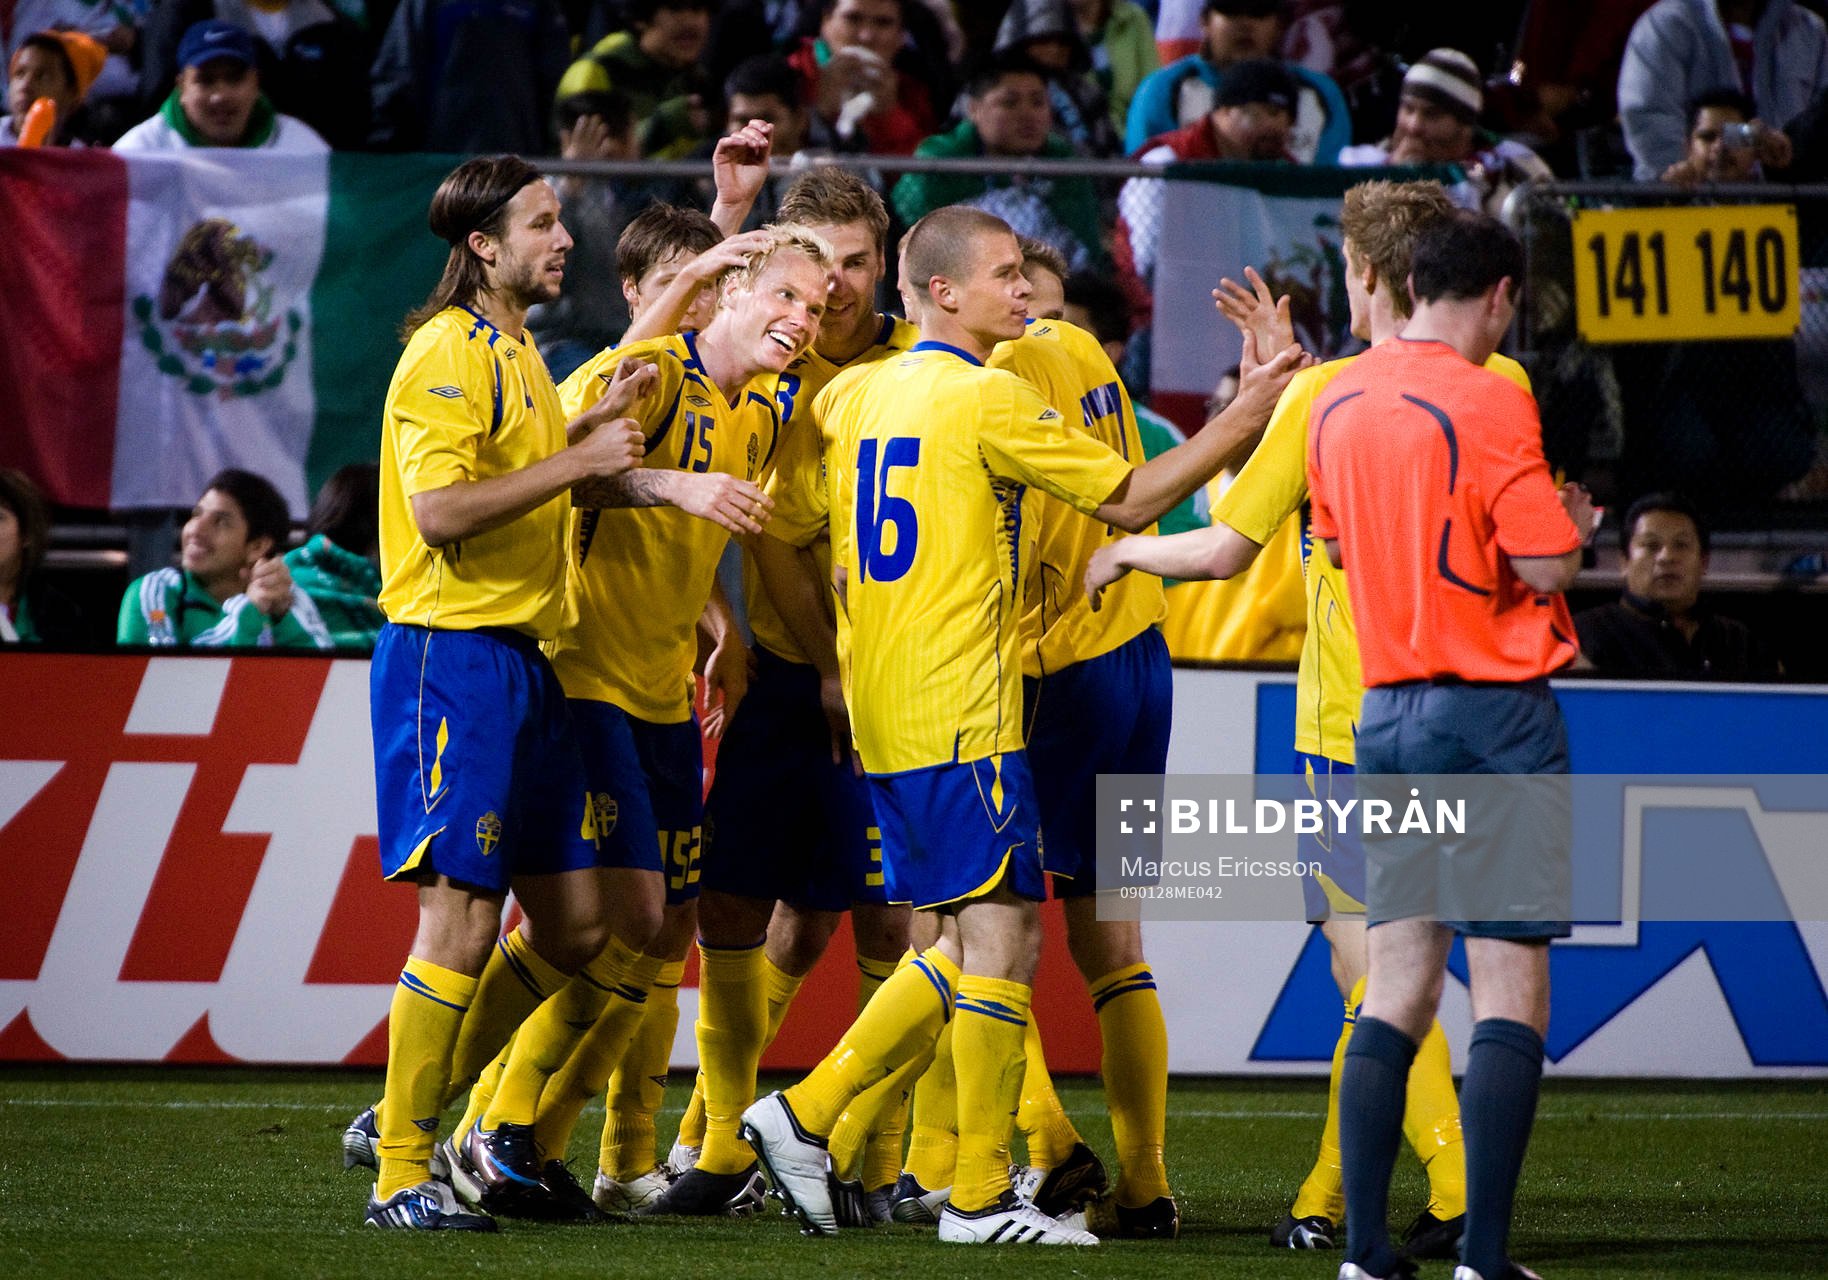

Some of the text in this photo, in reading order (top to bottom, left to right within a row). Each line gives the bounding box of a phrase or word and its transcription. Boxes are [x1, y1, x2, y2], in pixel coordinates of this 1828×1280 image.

[1589, 226, 1787, 317] 141 140
[678, 411, 714, 473] 15
[855, 437, 921, 585] 16
